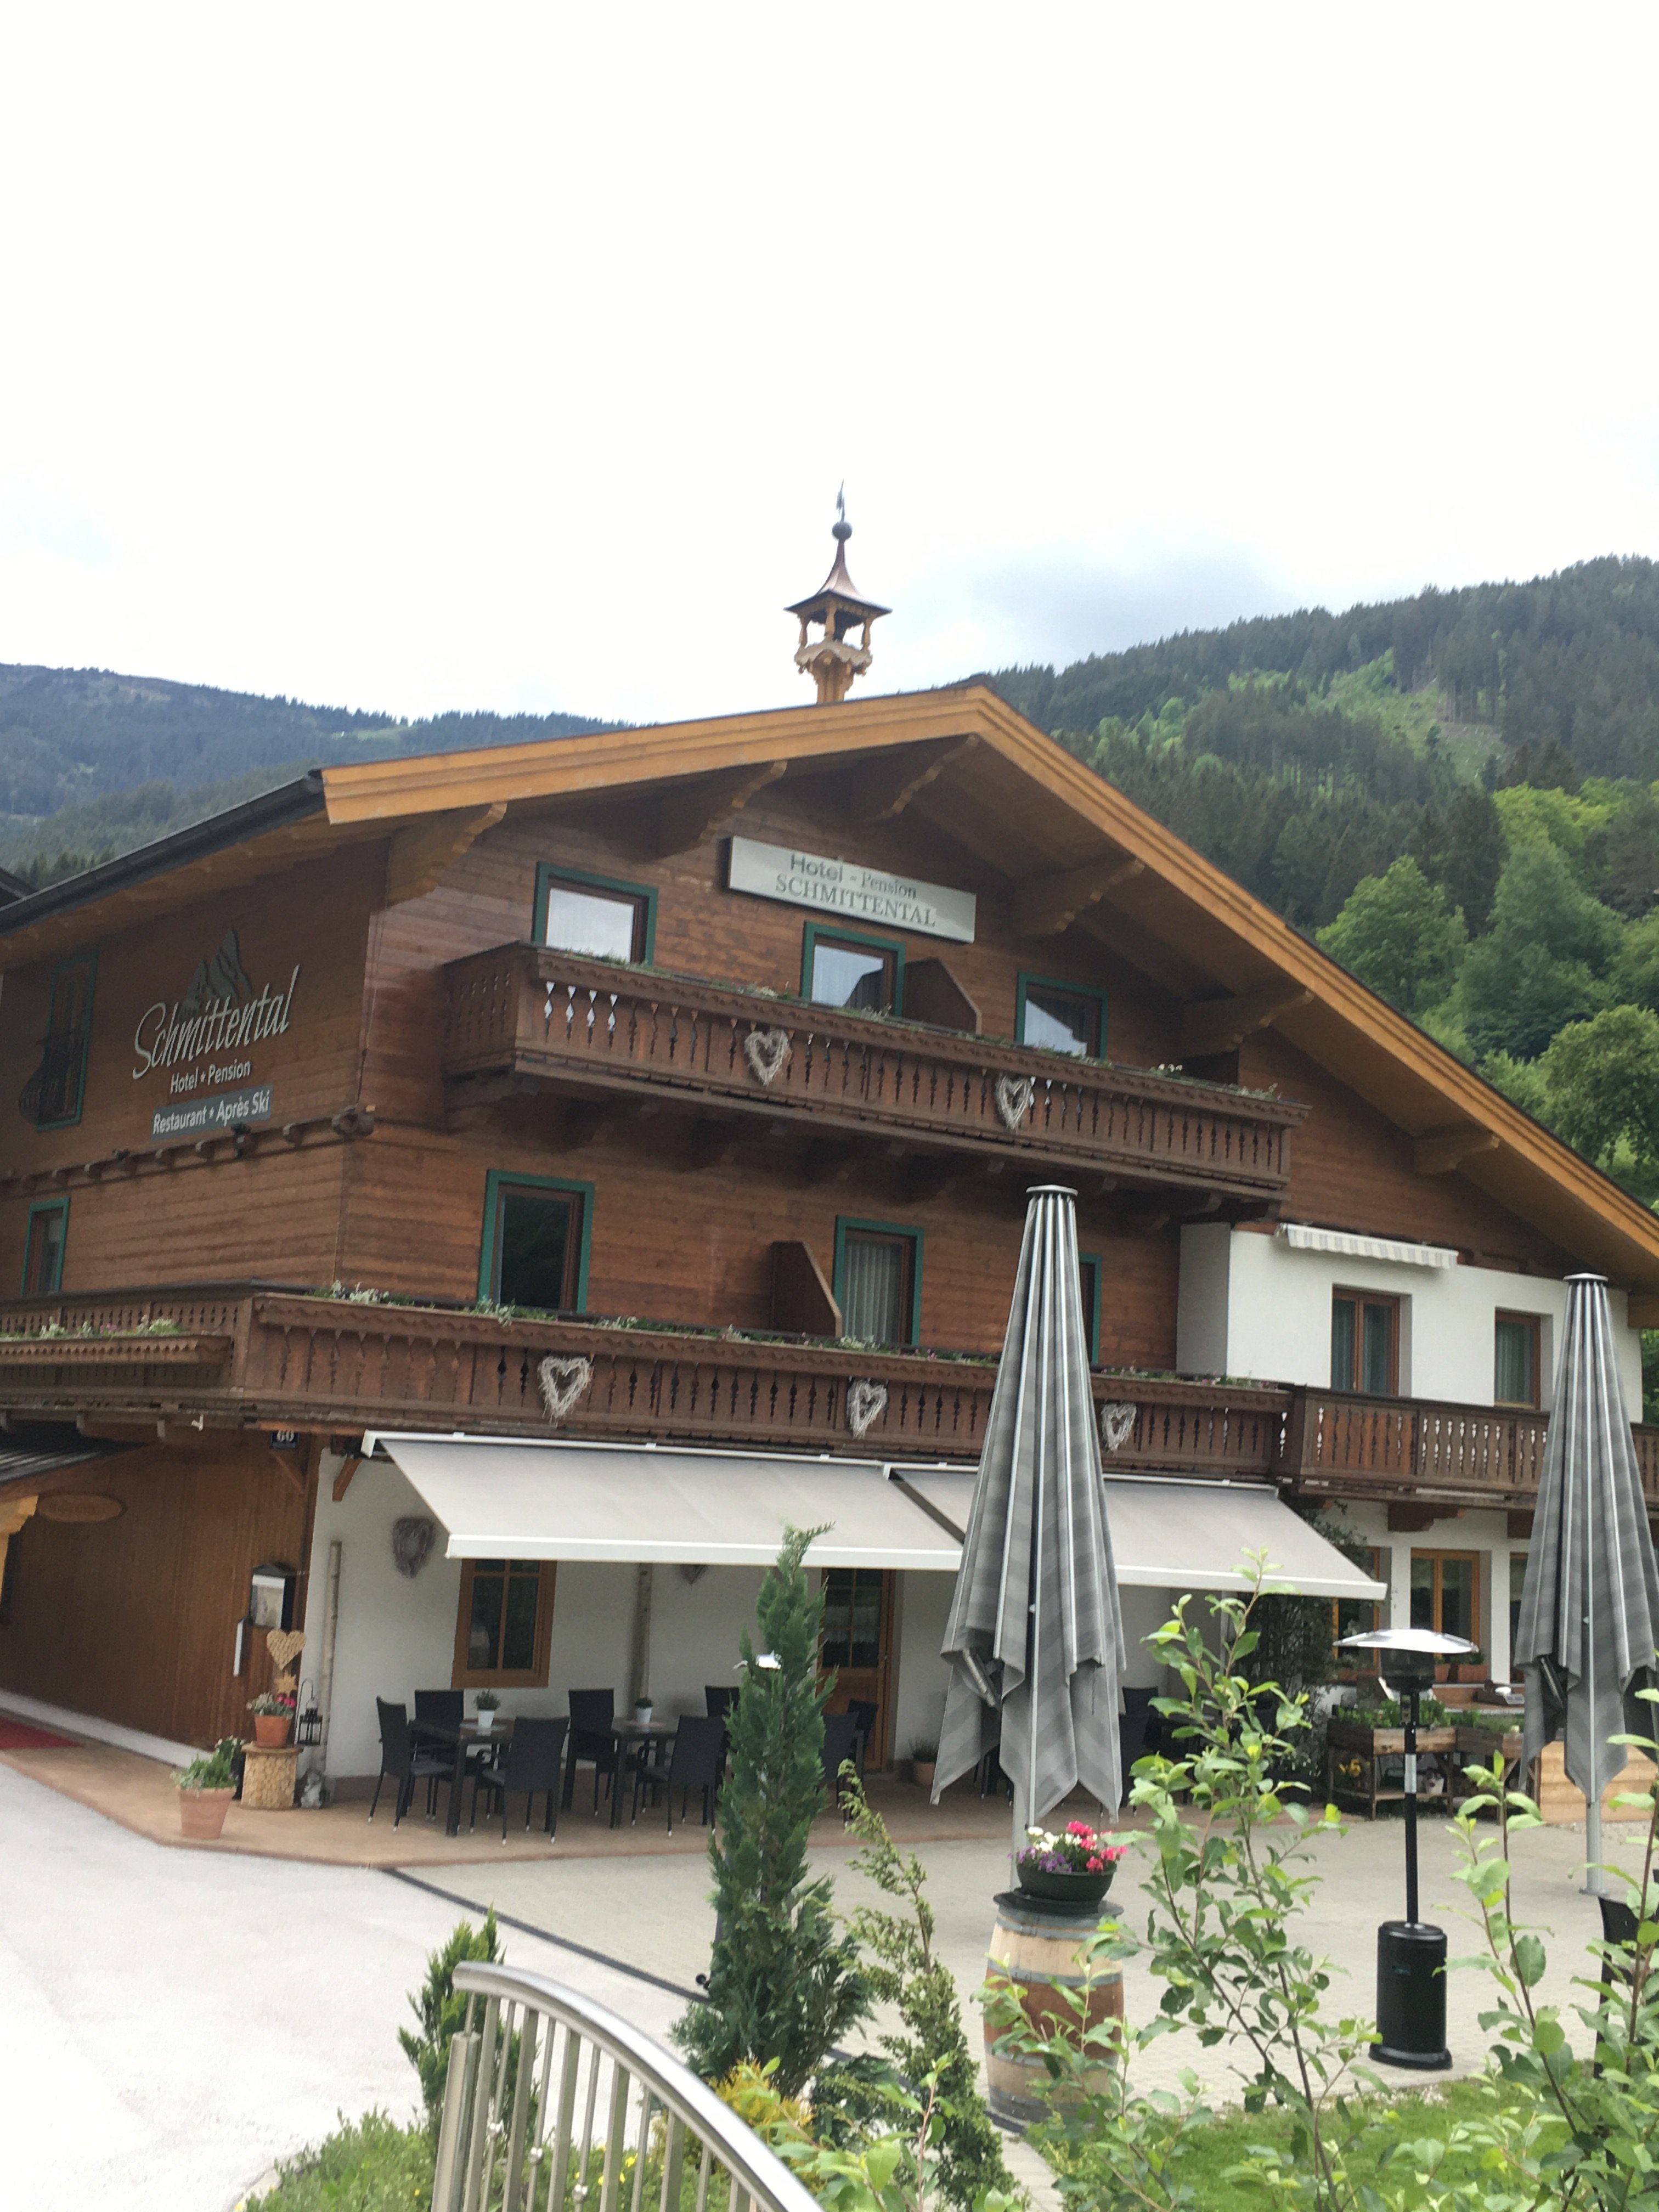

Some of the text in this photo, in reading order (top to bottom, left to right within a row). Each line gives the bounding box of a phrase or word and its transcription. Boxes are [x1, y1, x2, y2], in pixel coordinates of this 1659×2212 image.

[775, 872, 936, 928] SCHMITTENTAL
[790, 854, 843, 883] Hotel
[861, 871, 917, 900] Pension
[132, 964, 300, 1080] Schmittental
[170, 1058, 251, 1094] Hotel Pension
[153, 1090, 270, 1135] Restaurant Après Ski
